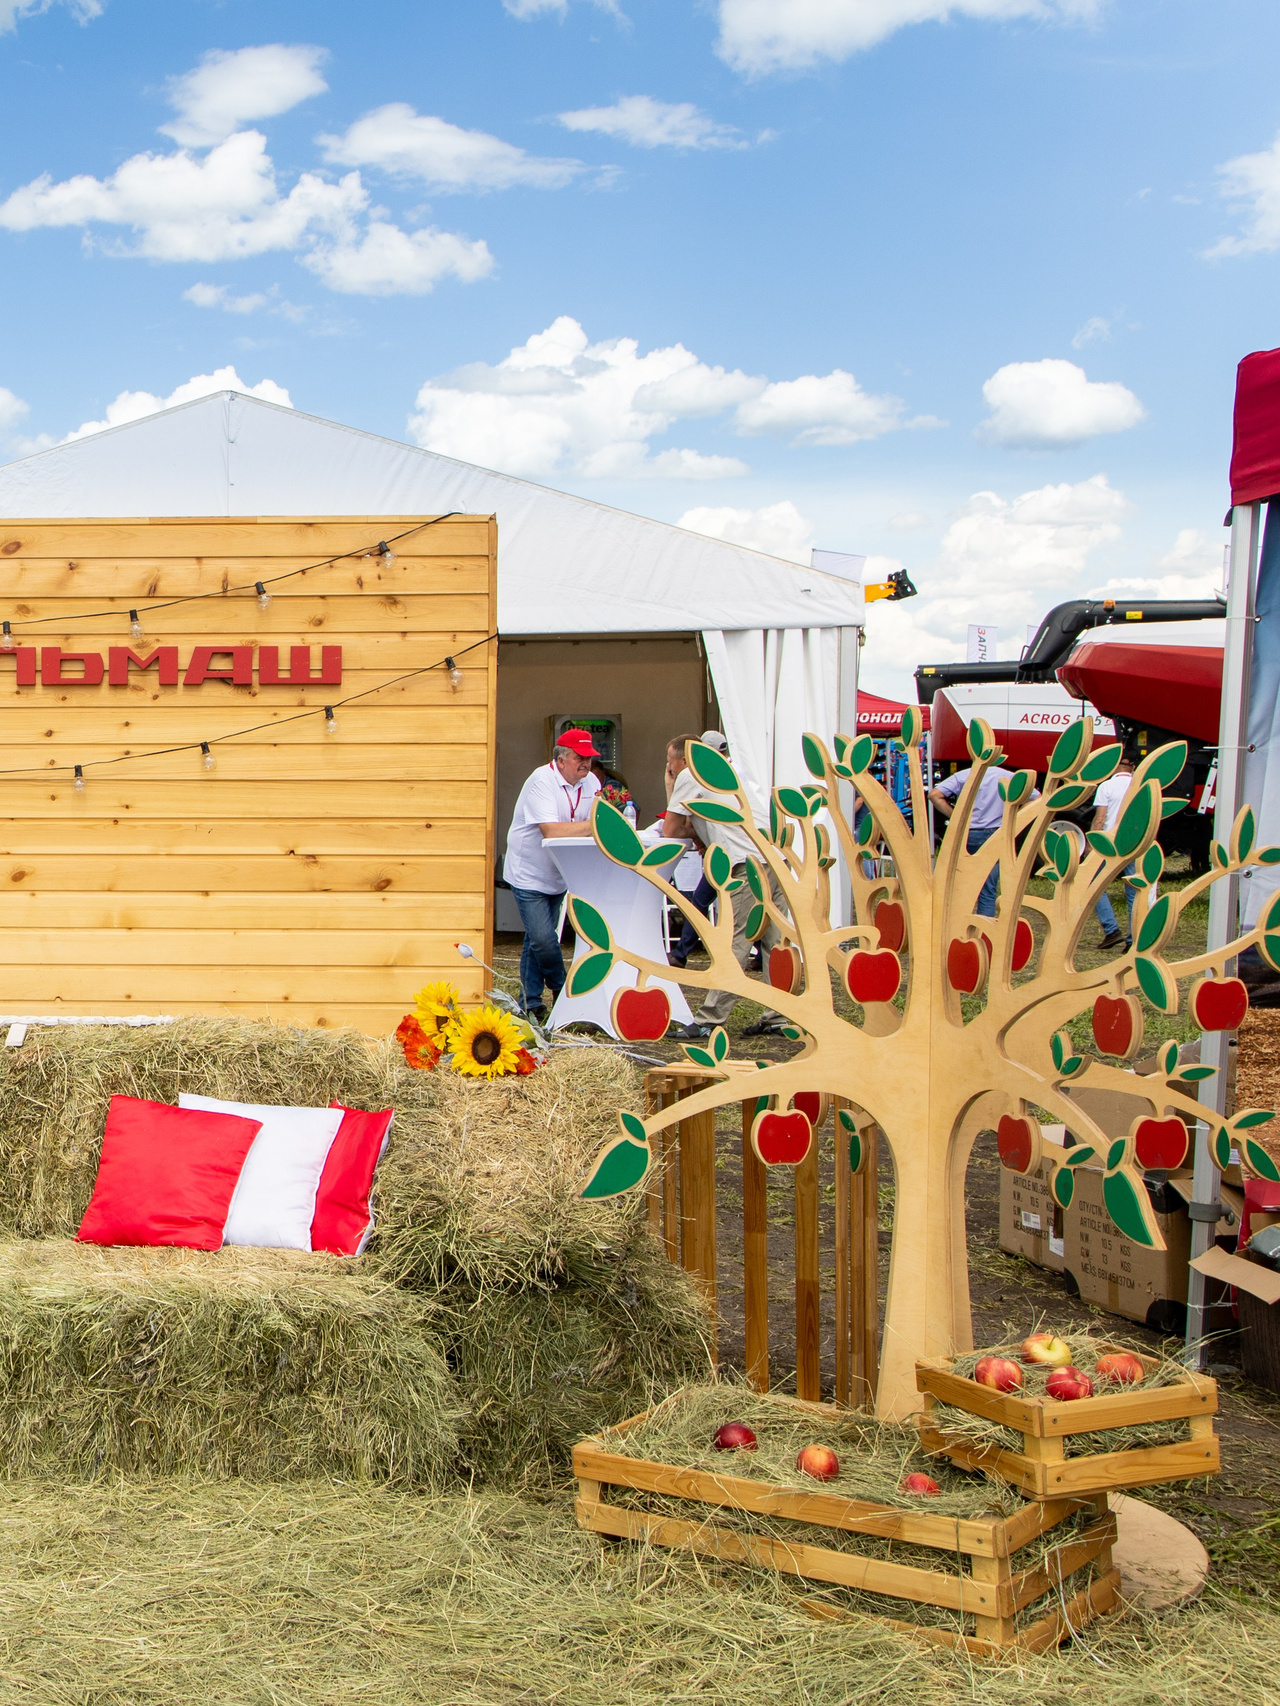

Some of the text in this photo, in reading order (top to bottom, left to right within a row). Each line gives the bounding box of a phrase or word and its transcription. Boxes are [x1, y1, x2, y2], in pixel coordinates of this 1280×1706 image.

[977, 627, 987, 662] ЗАПЧ
[1019, 713, 1070, 725] ACROS
[1013, 1175, 1031, 1191] ARTICLE
[1080, 1216, 1101, 1233] ARTICLE
[1120, 1243, 1131, 1257] KGS
[1120, 1260, 1131, 1273] KGS
